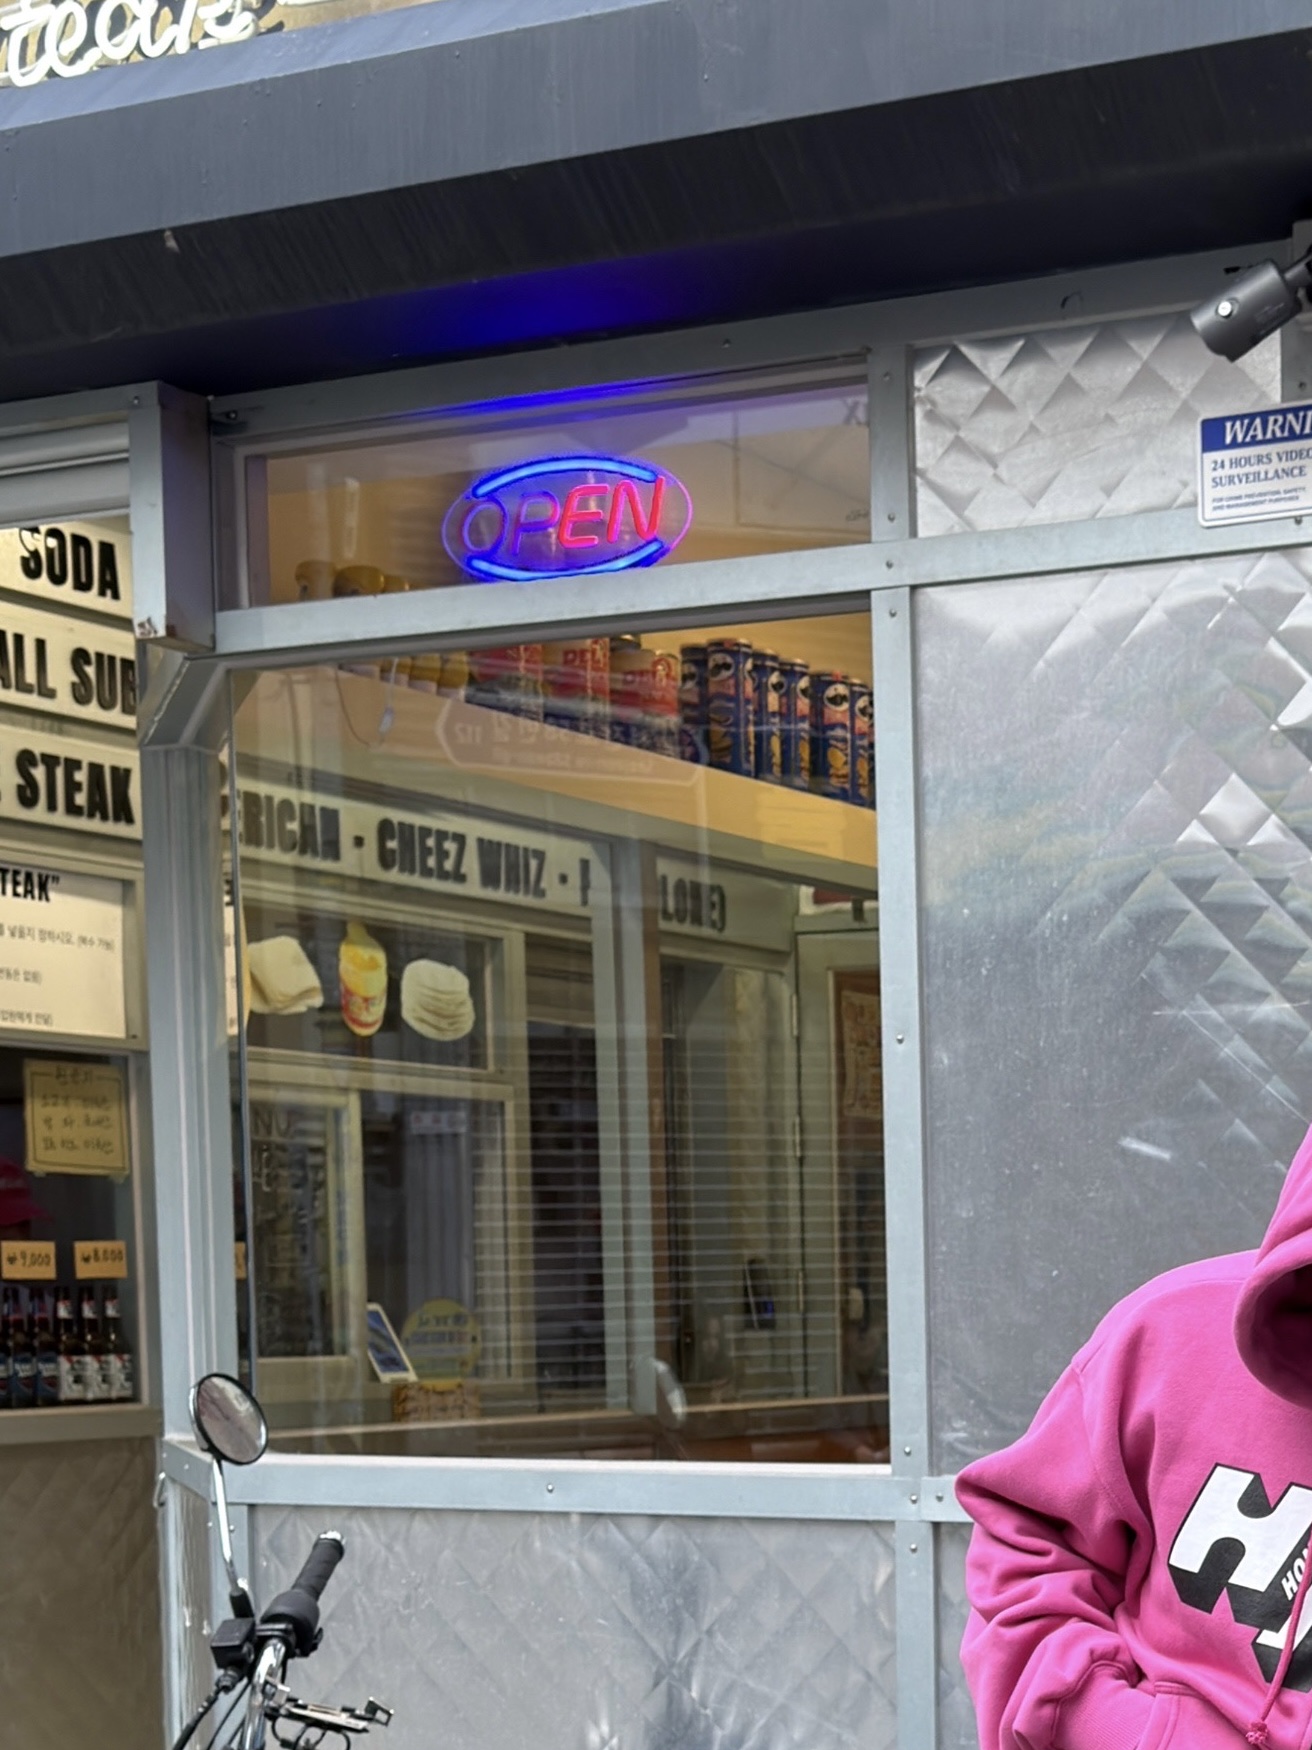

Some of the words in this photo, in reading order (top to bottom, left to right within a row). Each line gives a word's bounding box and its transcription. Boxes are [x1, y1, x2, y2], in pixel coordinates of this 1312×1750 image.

[1212, 459, 1225, 471] 24
[1229, 452, 1273, 469] HOURS
[1212, 465, 1307, 488] SURVEILLANCE
[462, 475, 666, 556] OPEN
[20, 527, 121, 601] SODA
[15, 748, 135, 825] STEAK
[237, 789, 341, 862] RICAN
[376, 818, 467, 885] CHEEZ
[475, 837, 546, 899] WHIZ
